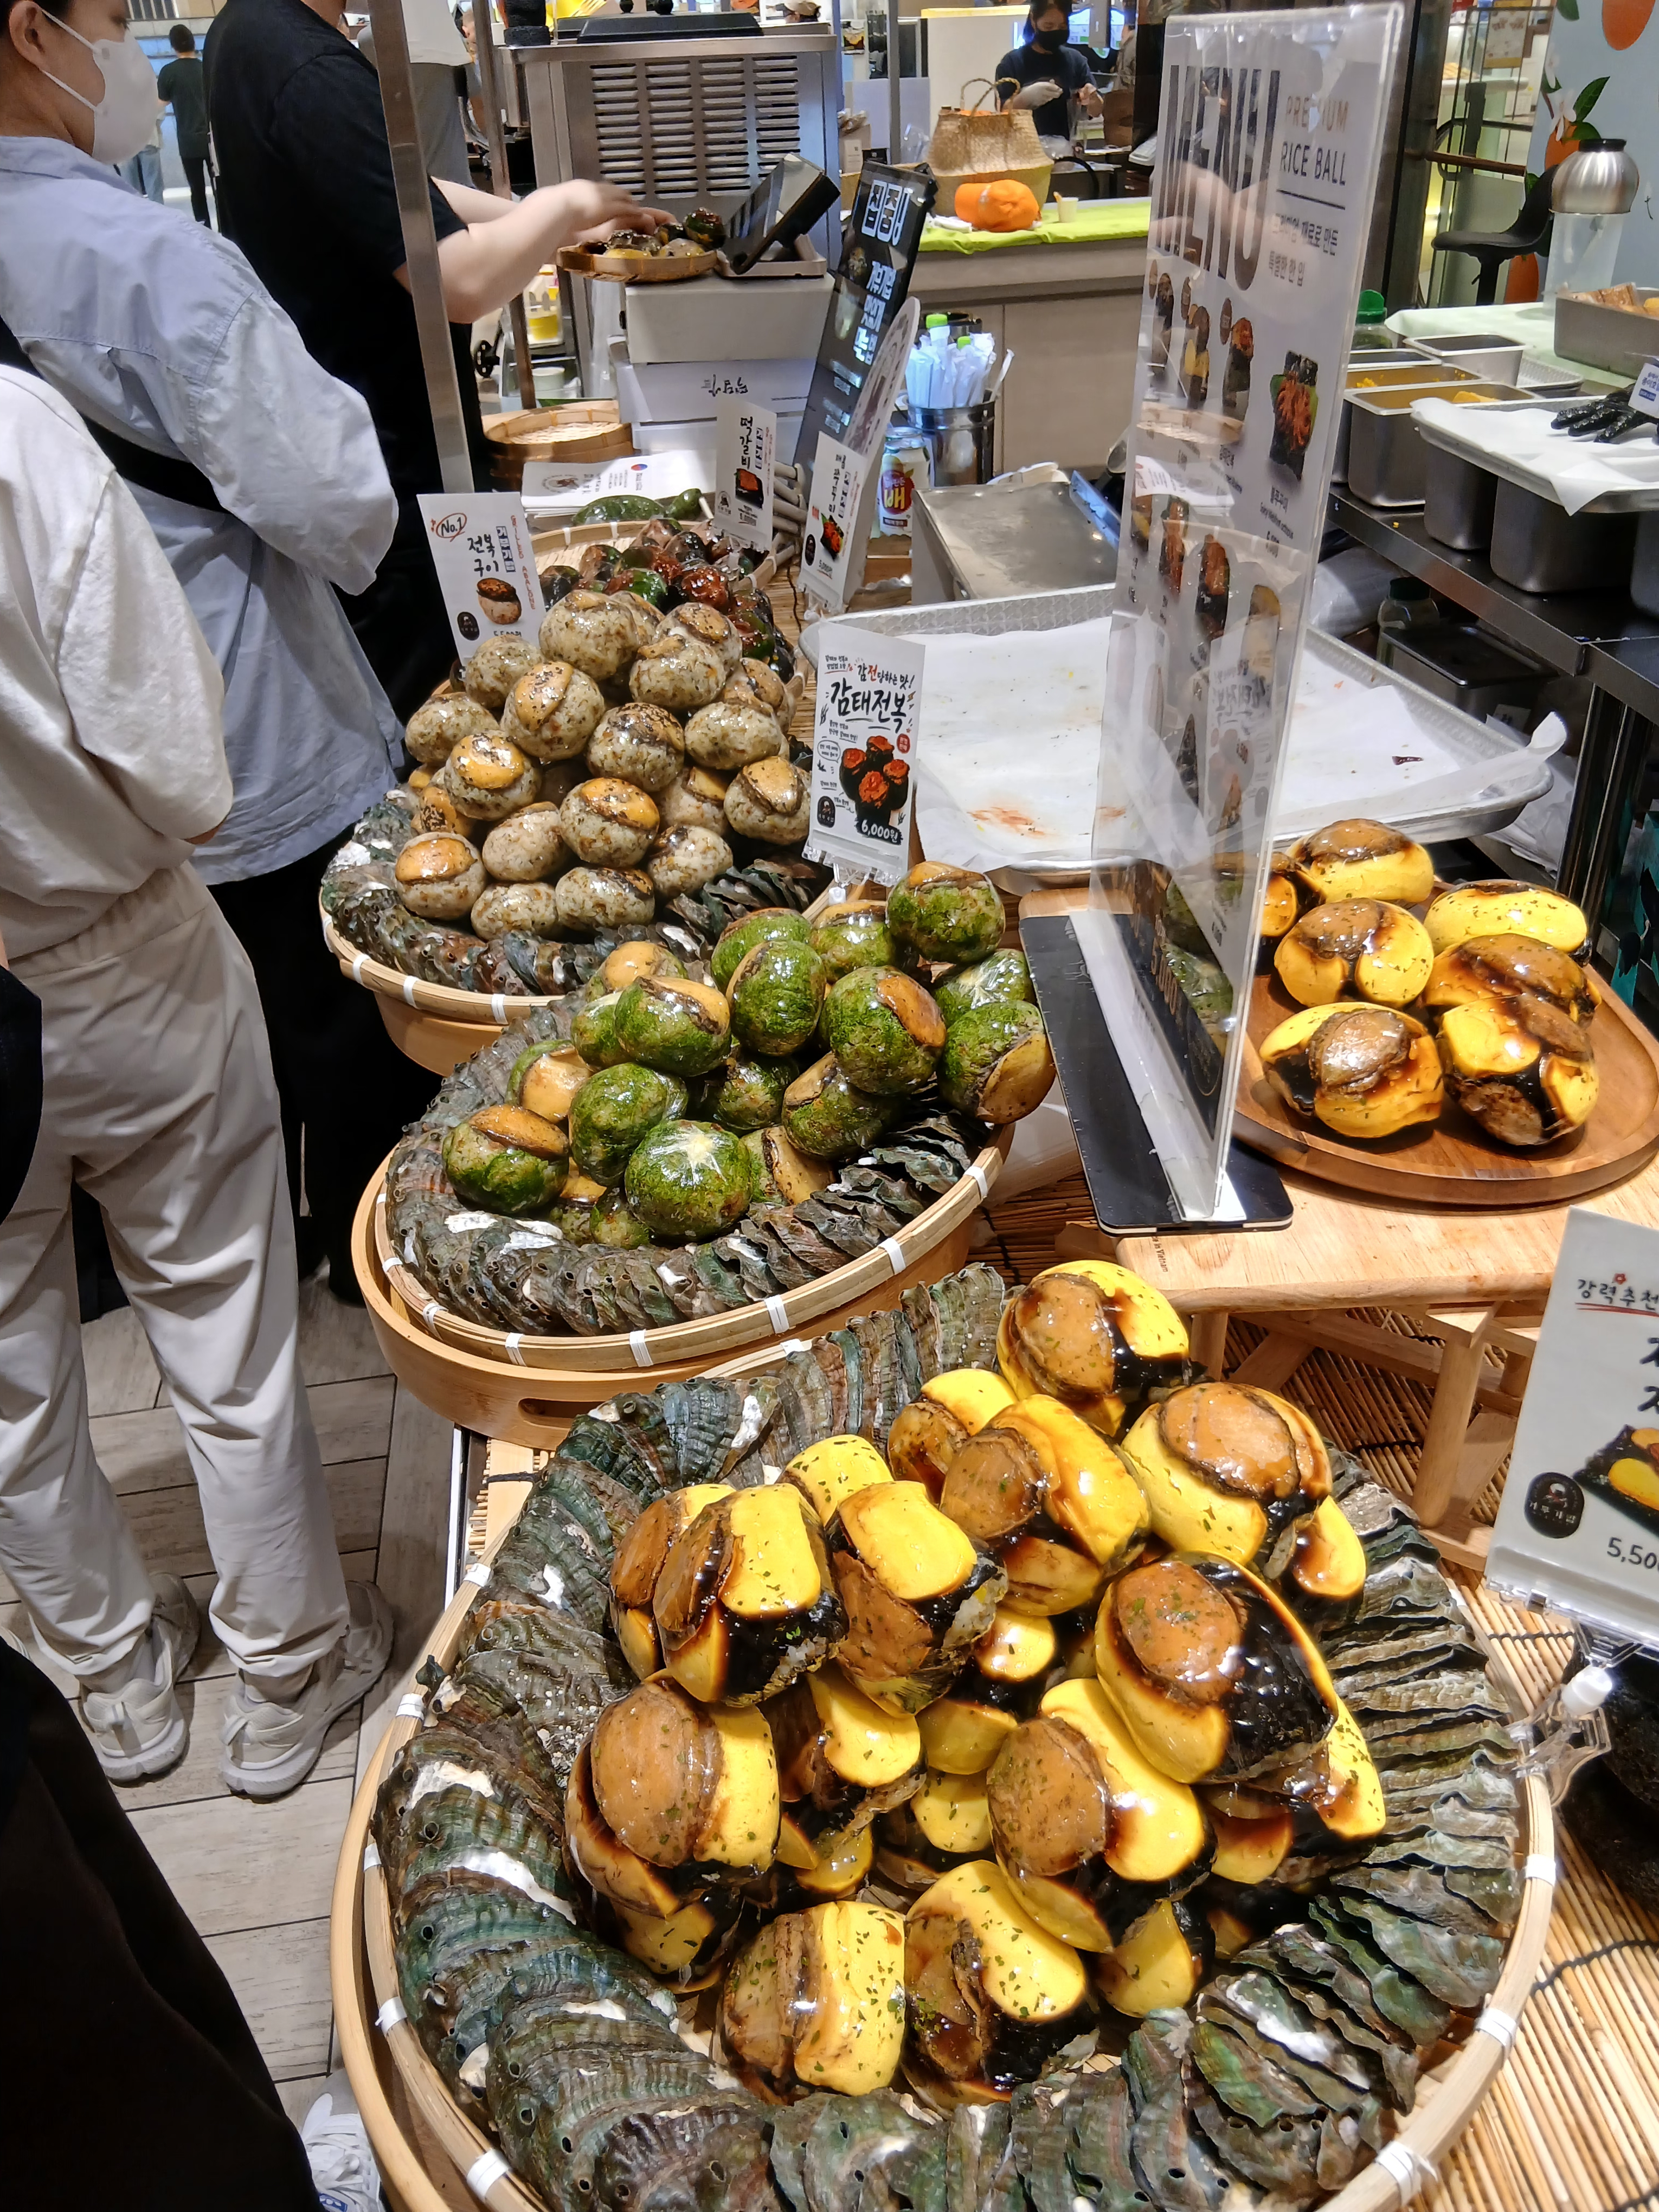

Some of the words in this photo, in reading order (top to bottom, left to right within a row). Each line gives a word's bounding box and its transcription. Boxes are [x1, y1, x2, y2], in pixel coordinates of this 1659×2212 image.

[1285, 95, 1349, 132] PREIUM
[1155, 64, 1280, 291] MENU
[1279, 141, 1310, 178] RICE
[1314, 150, 1346, 187] BALL
[861, 179, 910, 246] 집중!
[1301, 221, 1323, 248] 재료로
[1322, 228, 1339, 256] 만든
[739, 416, 754, 470] 떡갈비
[441, 517, 462, 537] No.1
[467, 533, 496, 558] 전복
[473, 558, 499, 578] 구이
[857, 662, 898, 686] 감전당하는
[899, 674, 916, 691] 맛!
[831, 677, 907, 734] 감태전복
[861, 818, 899, 844] 6,000원
[1606, 1536, 1659, 1572] 5,50
